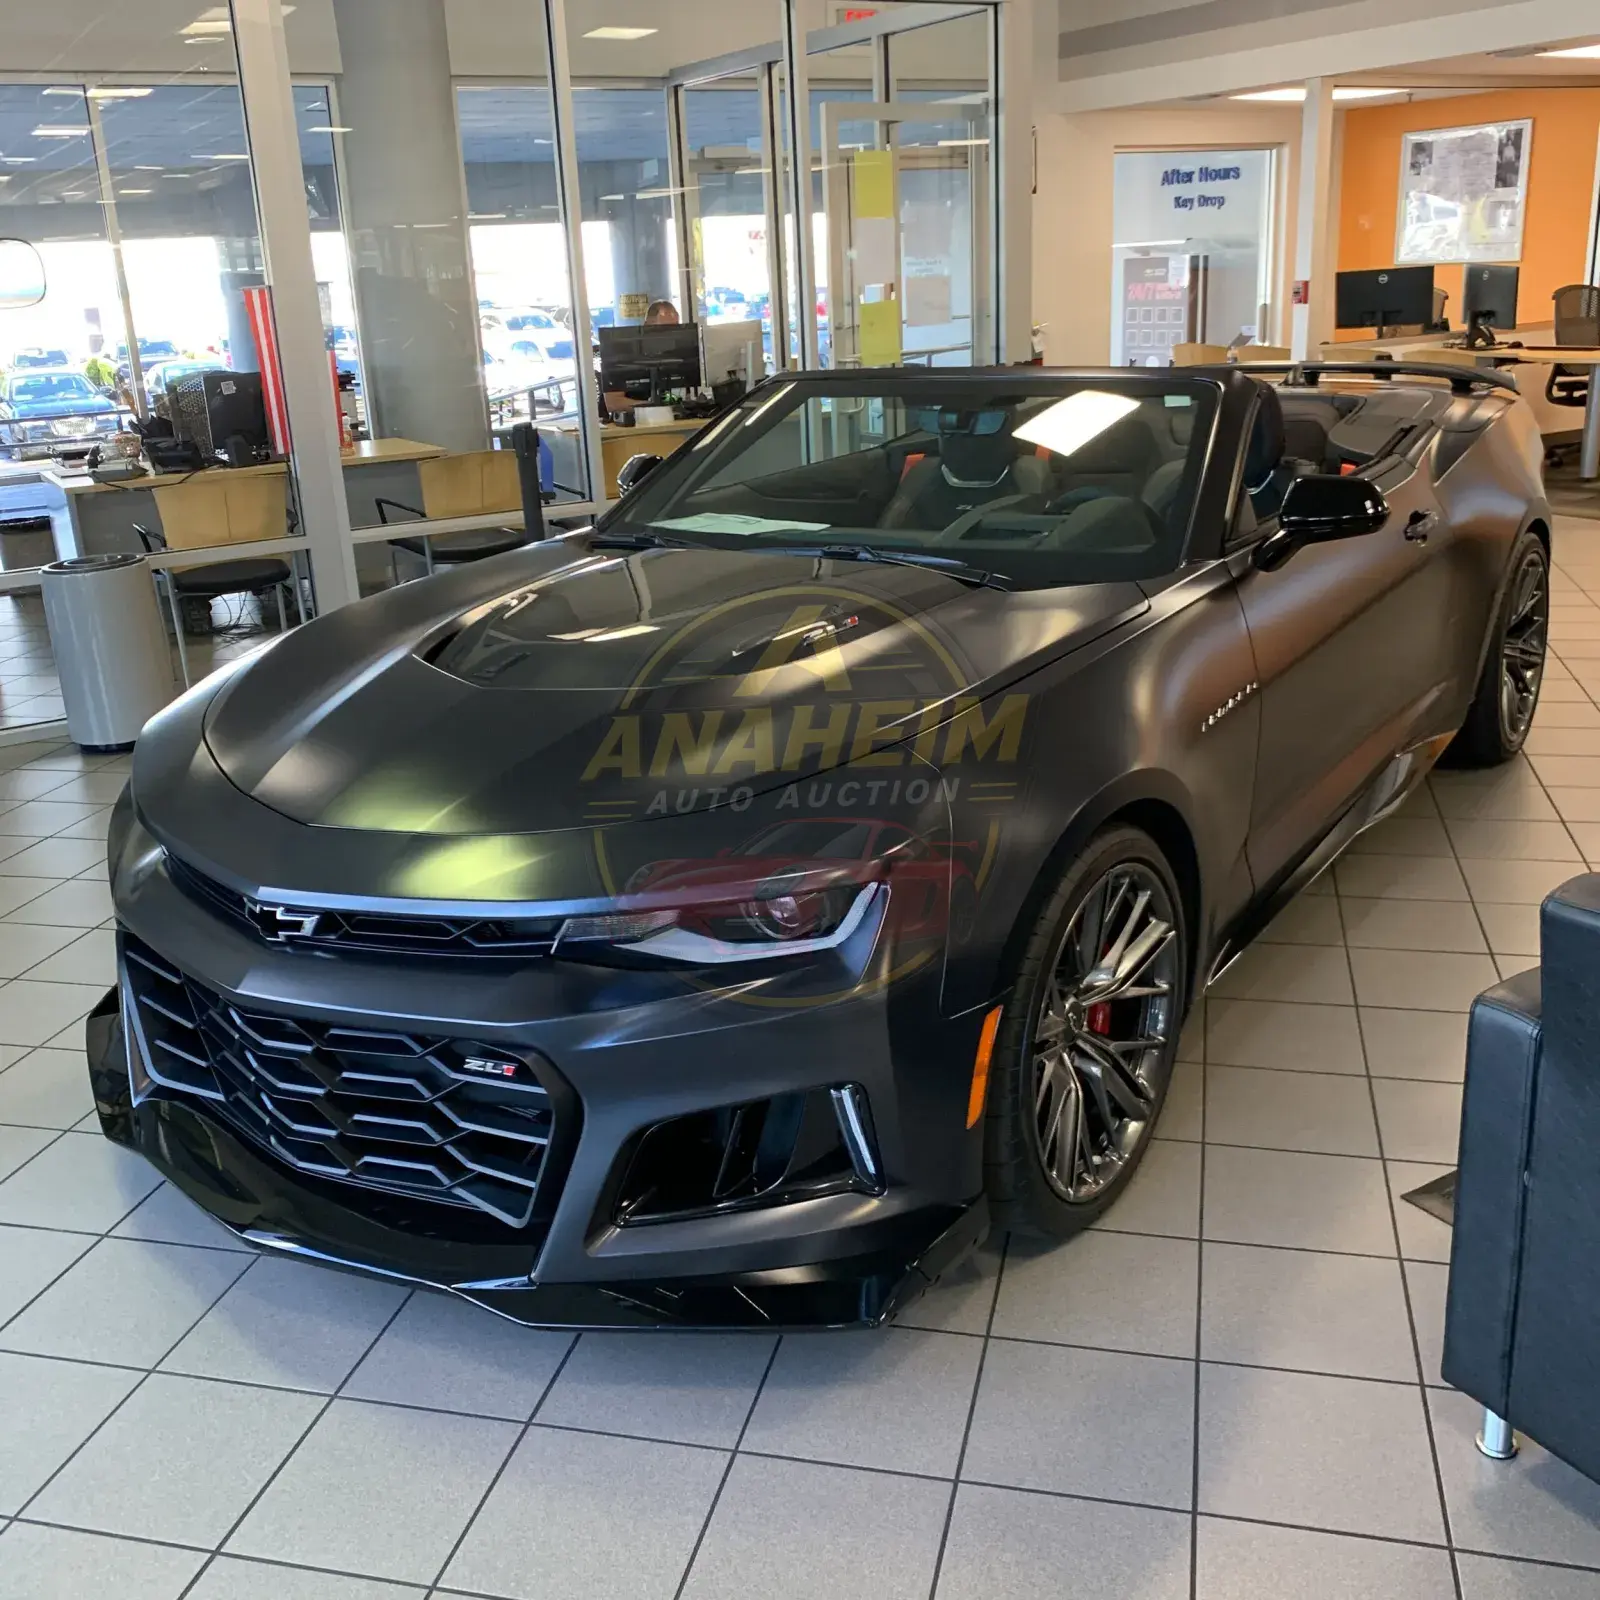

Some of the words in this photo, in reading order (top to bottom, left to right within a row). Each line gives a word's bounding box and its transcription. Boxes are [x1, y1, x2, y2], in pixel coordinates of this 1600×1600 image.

[1161, 169, 1195, 187] After
[1199, 165, 1241, 183] Hours
[1198, 194, 1226, 209] Drop
[463, 1057, 517, 1077] ZL1
